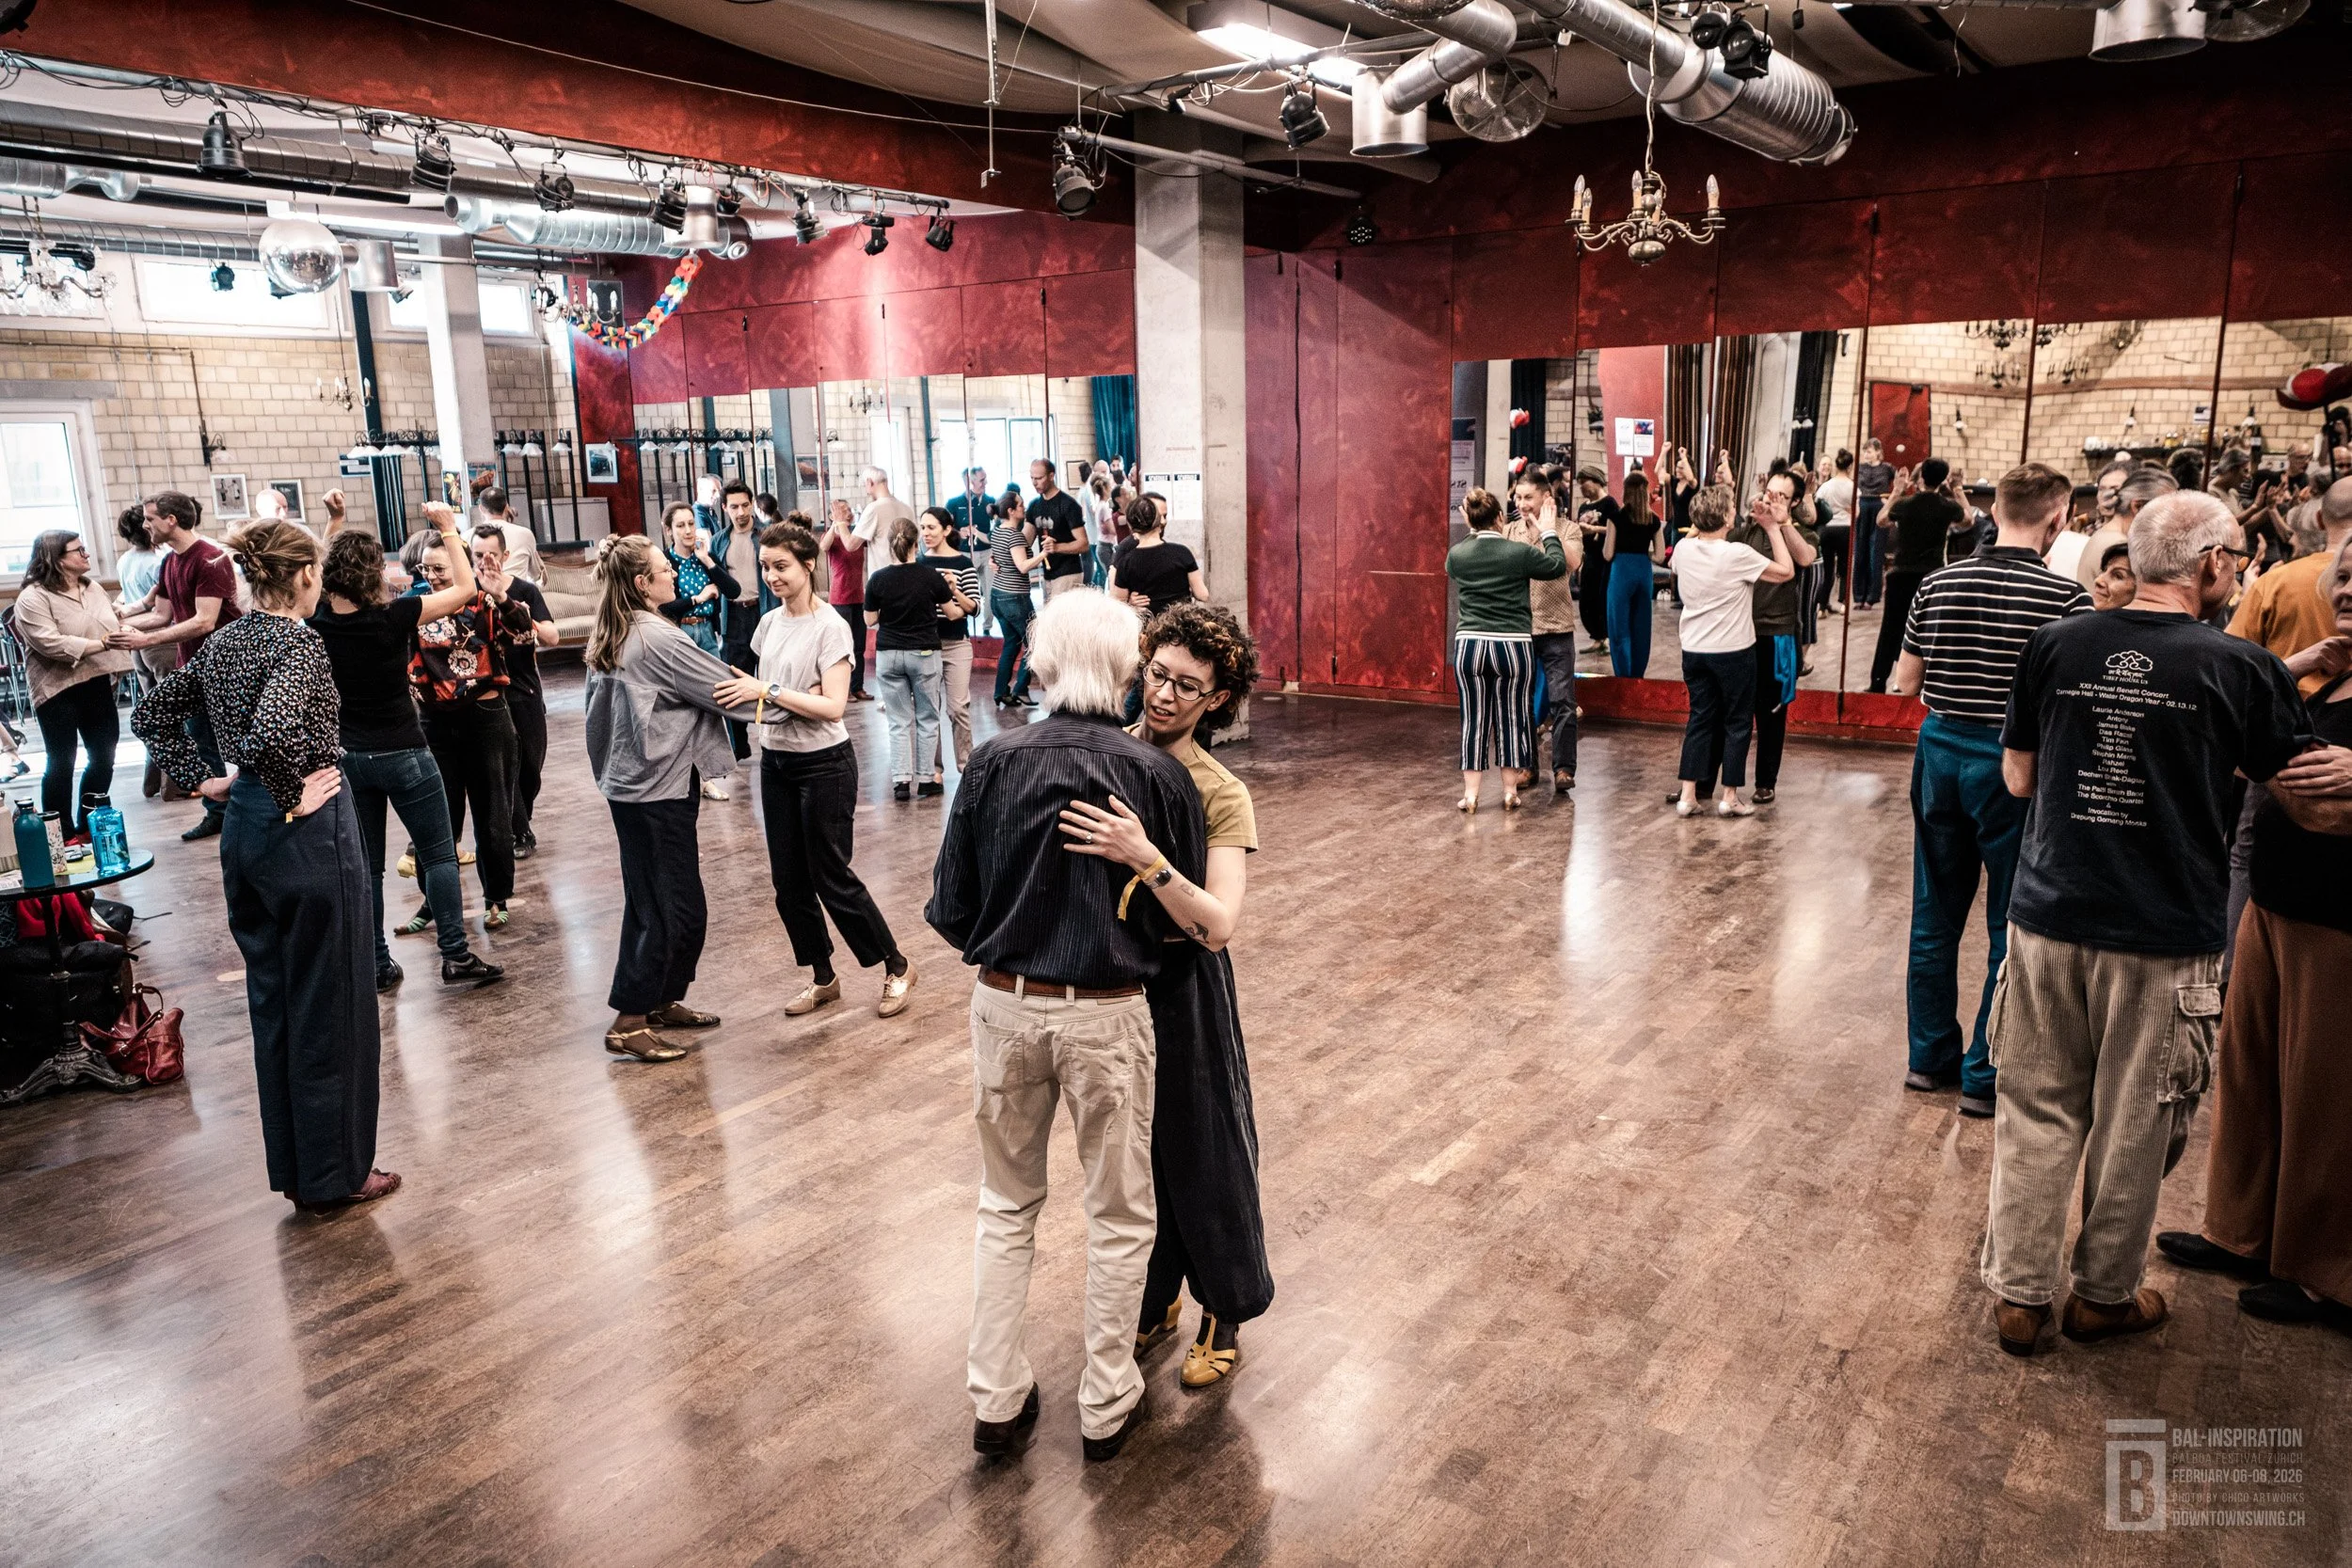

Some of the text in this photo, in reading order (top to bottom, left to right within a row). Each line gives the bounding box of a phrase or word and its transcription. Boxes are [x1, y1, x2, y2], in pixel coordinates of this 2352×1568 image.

[2092, 683, 2116, 692] Annual
[2116, 686, 2140, 695] Benefit
[2140, 689, 2169, 699] Concert
[2099, 691, 2119, 700] Water
[2119, 693, 2144, 704] Dragon
[2144, 697, 2161, 705] Year
[2091, 705, 2145, 718] Laurie Anderson
[2106, 715, 2129, 723] Antony
[2096, 721, 2119, 729] James
[2109, 767, 2129, 775] Reed
[2076, 790, 2090, 799] The
[2088, 807, 2120, 816] Invocation
